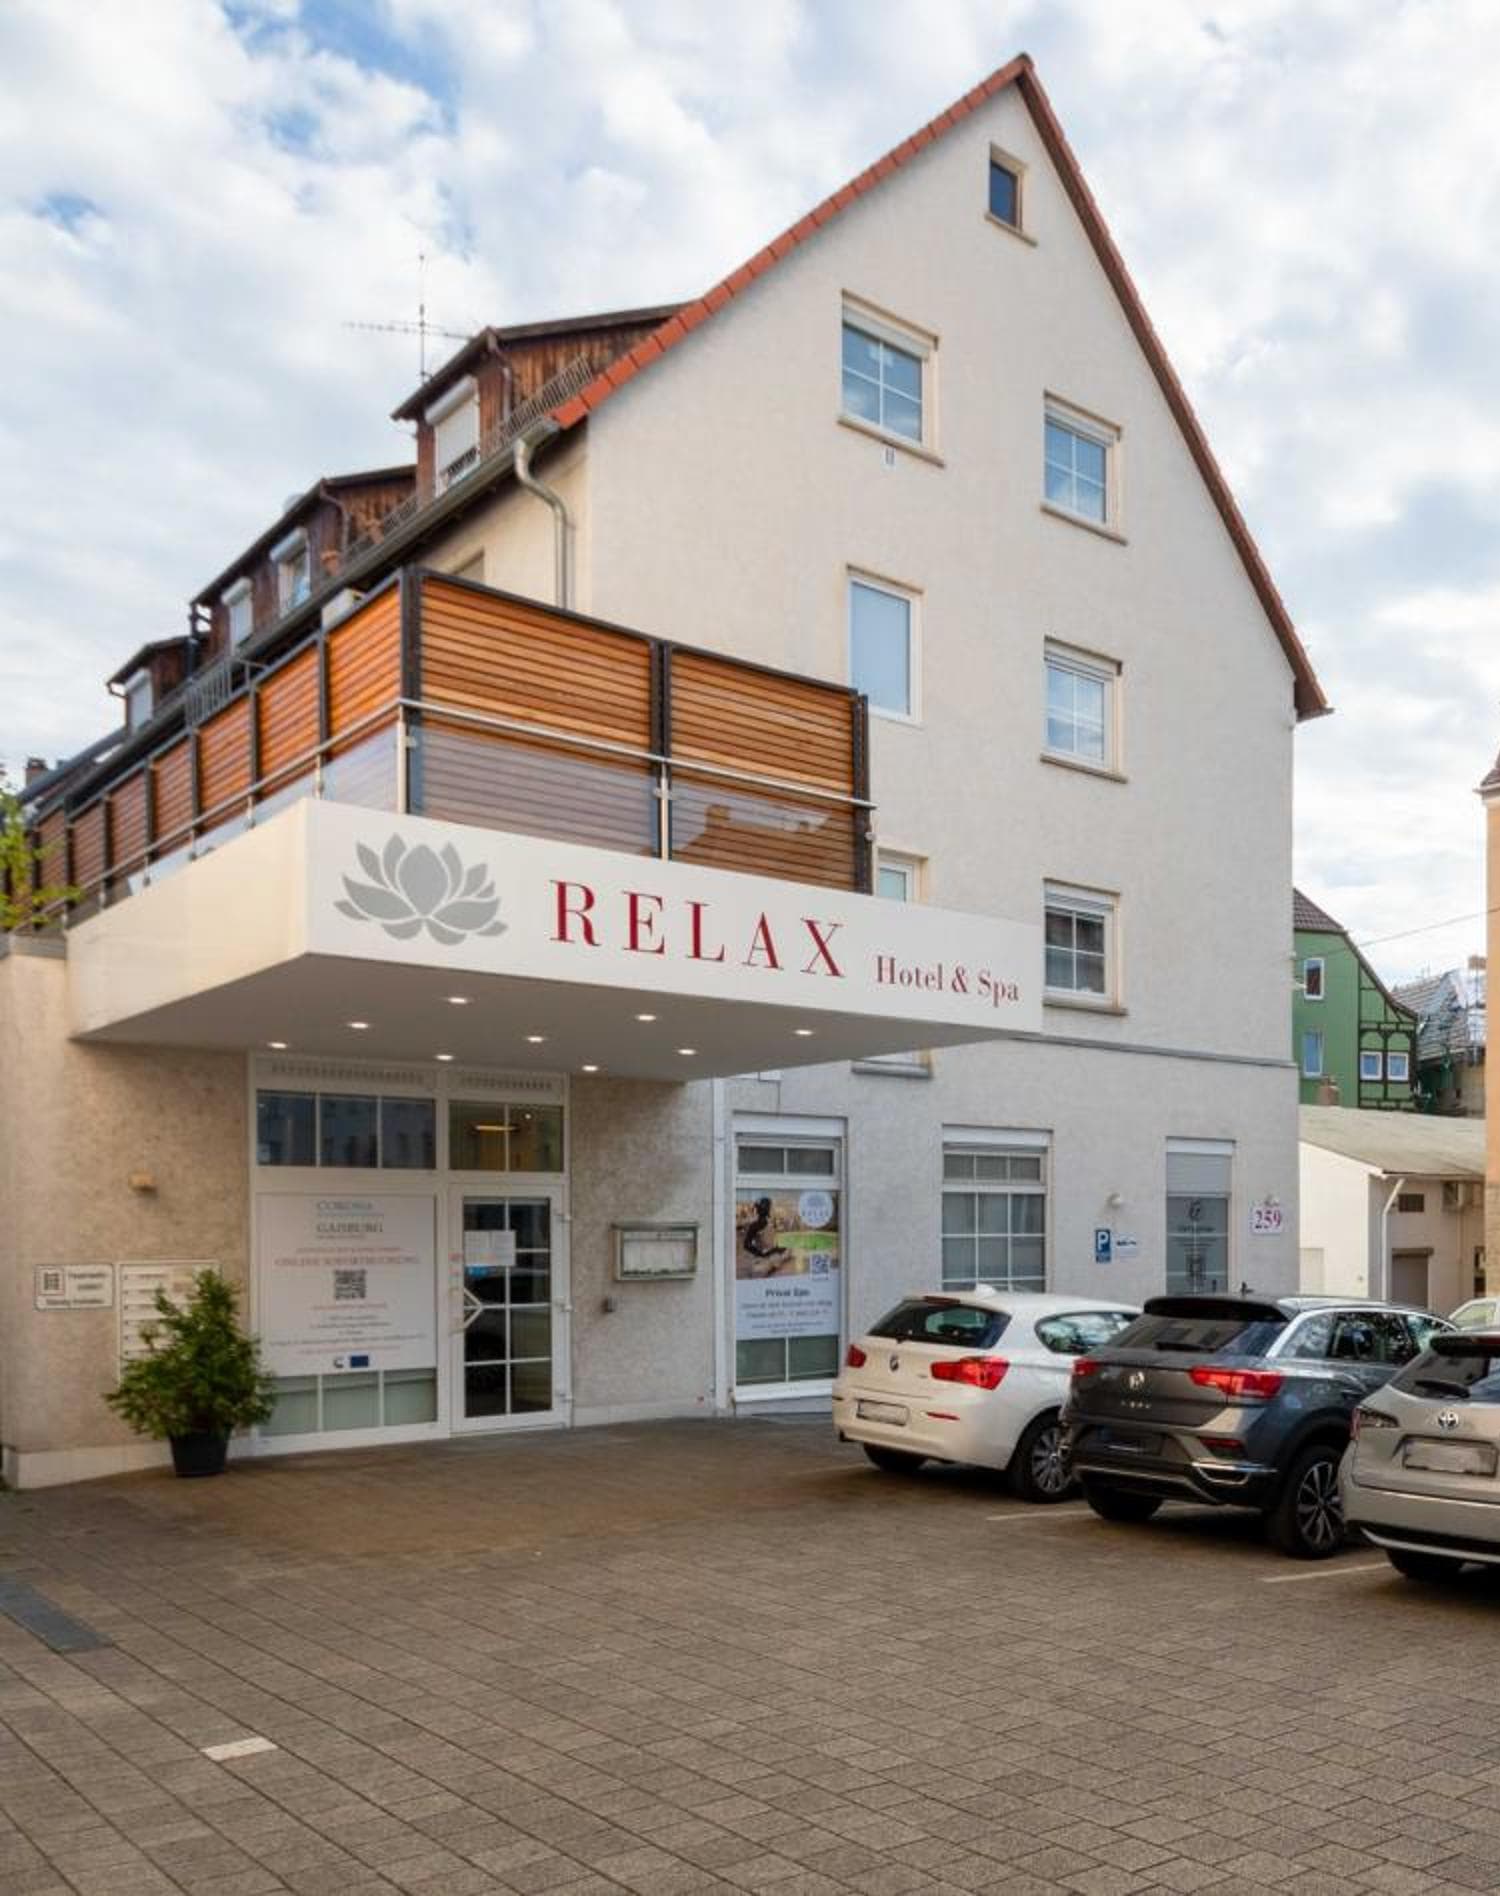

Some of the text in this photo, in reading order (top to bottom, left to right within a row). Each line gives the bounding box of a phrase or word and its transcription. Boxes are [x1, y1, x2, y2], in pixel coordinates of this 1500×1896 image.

[549, 878, 846, 978] RELAX
[875, 955, 1020, 1008] Hotel & Spa
[1254, 1209, 1282, 1229] 259
[1097, 1231, 1109, 1252] P
